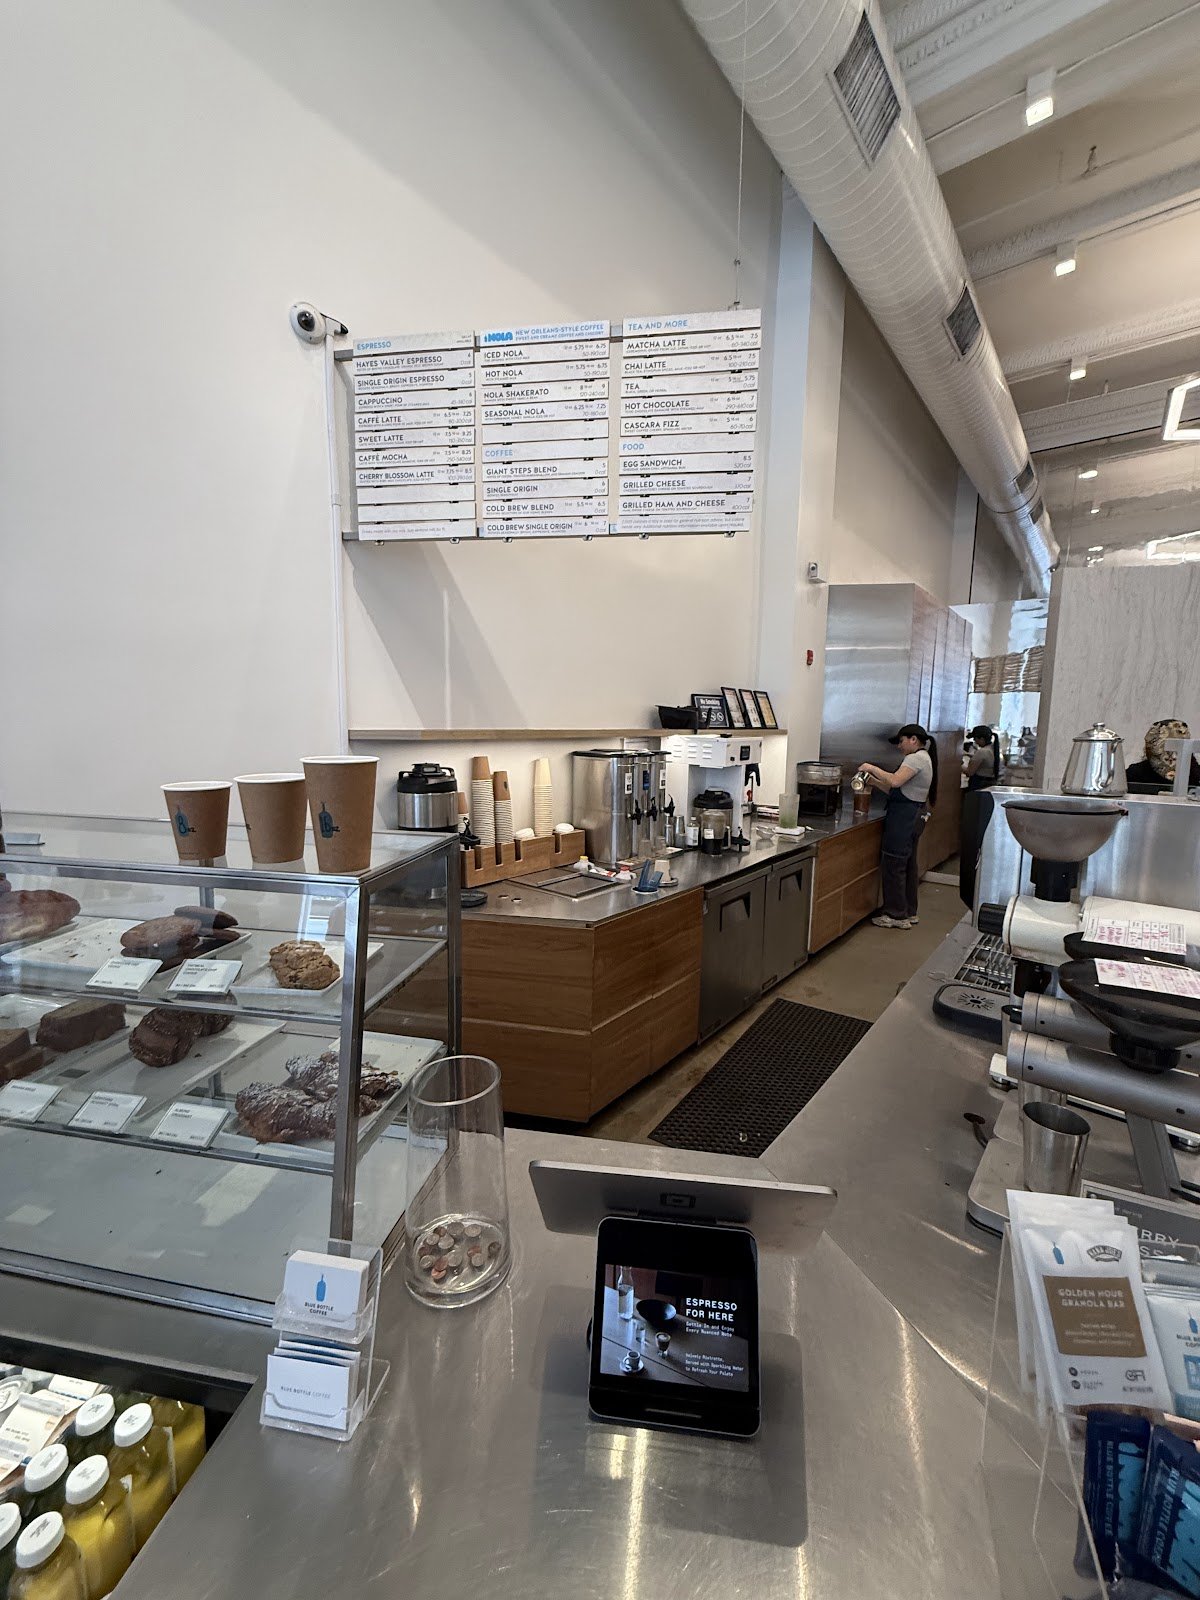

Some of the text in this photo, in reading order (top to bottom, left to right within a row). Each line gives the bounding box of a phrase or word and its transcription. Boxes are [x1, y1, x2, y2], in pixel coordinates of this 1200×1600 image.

[664, 320, 688, 328] MORE
[531, 325, 579, 335] ORLEANS-STYLE
[356, 341, 391, 350] ESPRESSO
[626, 341, 660, 349] MATCHA
[663, 339, 686, 347] LATTE
[484, 351, 501, 359] ICED
[380, 358, 405, 366] VALLEY
[407, 356, 442, 364] ESPRESSO
[624, 363, 643, 371] CHAI
[644, 361, 667, 369] LATTE
[485, 370, 500, 378] HOT
[410, 375, 445, 383] ESPRESSO
[484, 388, 549, 399] NOLA SHAKERATO
[358, 397, 403, 406] CAPPUCCINO
[643, 401, 690, 409] CHOCOLATE
[484, 409, 522, 417] SEASONAL
[624, 422, 660, 430] CASCARA
[640, 459, 682, 467] SANDWICH
[623, 481, 654, 489] GRILLED
[1058, 1288, 1124, 1298] GOLDEN HOUR
[317, 1303, 334, 1311] BOTTLE
[686, 1297, 737, 1311] ESPRESSO
[1062, 1299, 1105, 1308] GRANOLA
[309, 1308, 327, 1316] COFFEE
[686, 1309, 734, 1322] FOR HERE
[293, 1389, 311, 1397] BOTTLE
[312, 1391, 331, 1399] COFFEE
[1105, 1440, 1114, 1537] BLUE BOTTLE COFFEE
